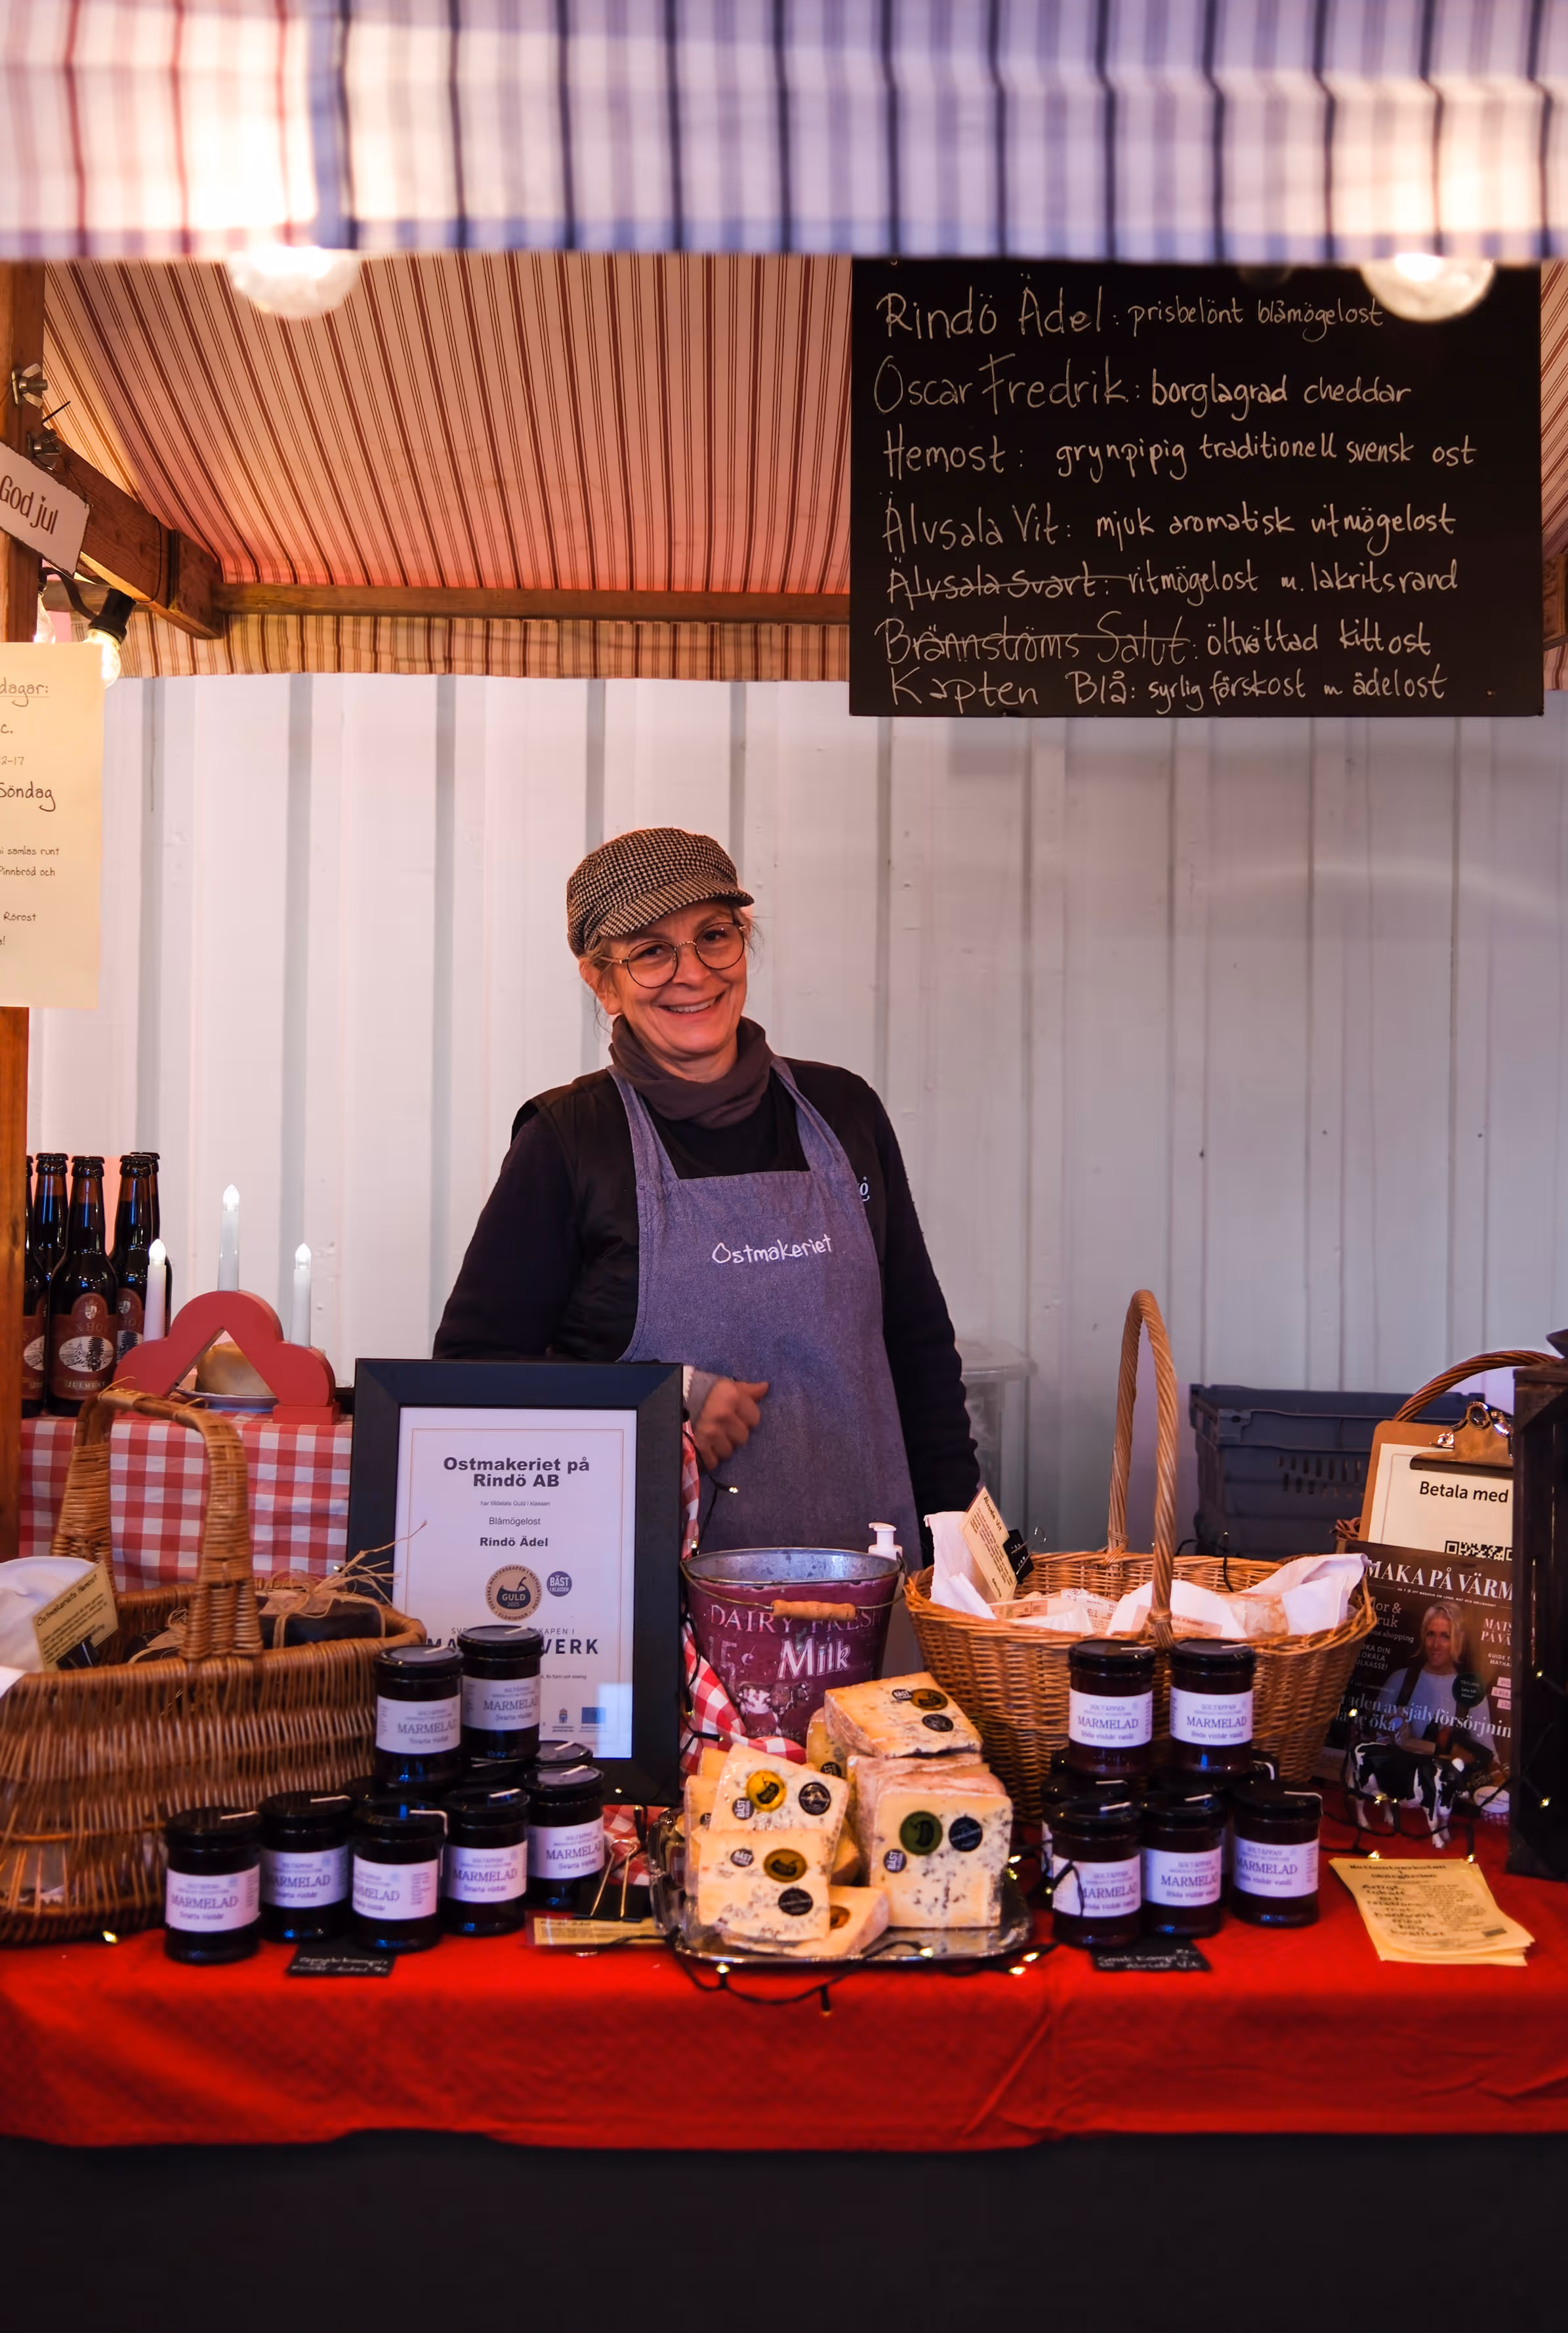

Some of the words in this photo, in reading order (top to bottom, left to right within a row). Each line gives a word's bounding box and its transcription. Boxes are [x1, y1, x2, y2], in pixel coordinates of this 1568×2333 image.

[877, 285, 997, 339] Rindö
[1128, 295, 1243, 337] prisbelönt
[1258, 297, 1384, 343] blåmögelost
[874, 355, 973, 414] Oscar
[978, 353, 1140, 415] Fredrik:
[1152, 368, 1288, 421] borglagrad
[1304, 376, 1412, 404] cheddar
[1056, 438, 1187, 483] grynpipig
[1199, 431, 1337, 459] traditionell
[1347, 432, 1414, 463] svensk
[1432, 435, 1477, 467] ost
[0, 474, 35, 518] God
[30, 495, 58, 535] jul
[879, 491, 1003, 554] Älvsala
[1097, 507, 1155, 551] mjuk
[1169, 501, 1295, 535] aromatisk
[1312, 502, 1456, 556] vitmögelost
[887, 556, 1001, 611] Älvsala
[1281, 575, 1304, 591] m.
[1312, 558, 1458, 593] lakritsrand
[874, 615, 1081, 664] Brännströms
[1207, 616, 1318, 656] öltvättad
[891, 667, 1039, 714] Kapten
[1148, 674, 1203, 715] syrlig
[1353, 663, 1448, 700] ädelost
[0, 781, 56, 812] Söndag
[7, 845, 37, 855] samlas
[40, 847, 60, 856] runt
[40, 867, 56, 876] och
[712, 1233, 833, 1264] Ostmakeriet
[444, 1456, 561, 1471] Ostmakeriet
[567, 1456, 590, 1475] på
[473, 1473, 527, 1487] Rindö
[532, 1474, 560, 1488] AB
[1420, 1481, 1468, 1500] Betala
[1473, 1489, 1509, 1503] med
[489, 1517, 541, 1527] Blåmögelost
[480, 1536, 516, 1547] Rindö
[520, 1535, 548, 1547] Ädel
[550, 1574, 569, 1587] BÄST
[1429, 1566, 1453, 1591] PÅ
[502, 1593, 526, 1601] GULD
[1382, 1630, 1414, 1643] shopping
[1481, 1630, 1495, 1643] PÅ
[776, 1635, 852, 1680] Milk
[1377, 1646, 1391, 1654] DIN
[1489, 1659, 1512, 1668] MATHA
[1077, 1715, 1139, 1729] MARMELAD
[1186, 1715, 1247, 1729] MARMELAD
[736, 1797, 746, 1818] BÄST
[1236, 1857, 1298, 1875] MARMELAD
[267, 1874, 331, 1888] ARMELAD
[453, 1868, 517, 1881] MARMELAD
[171, 1895, 239, 1909] MARMELAD
